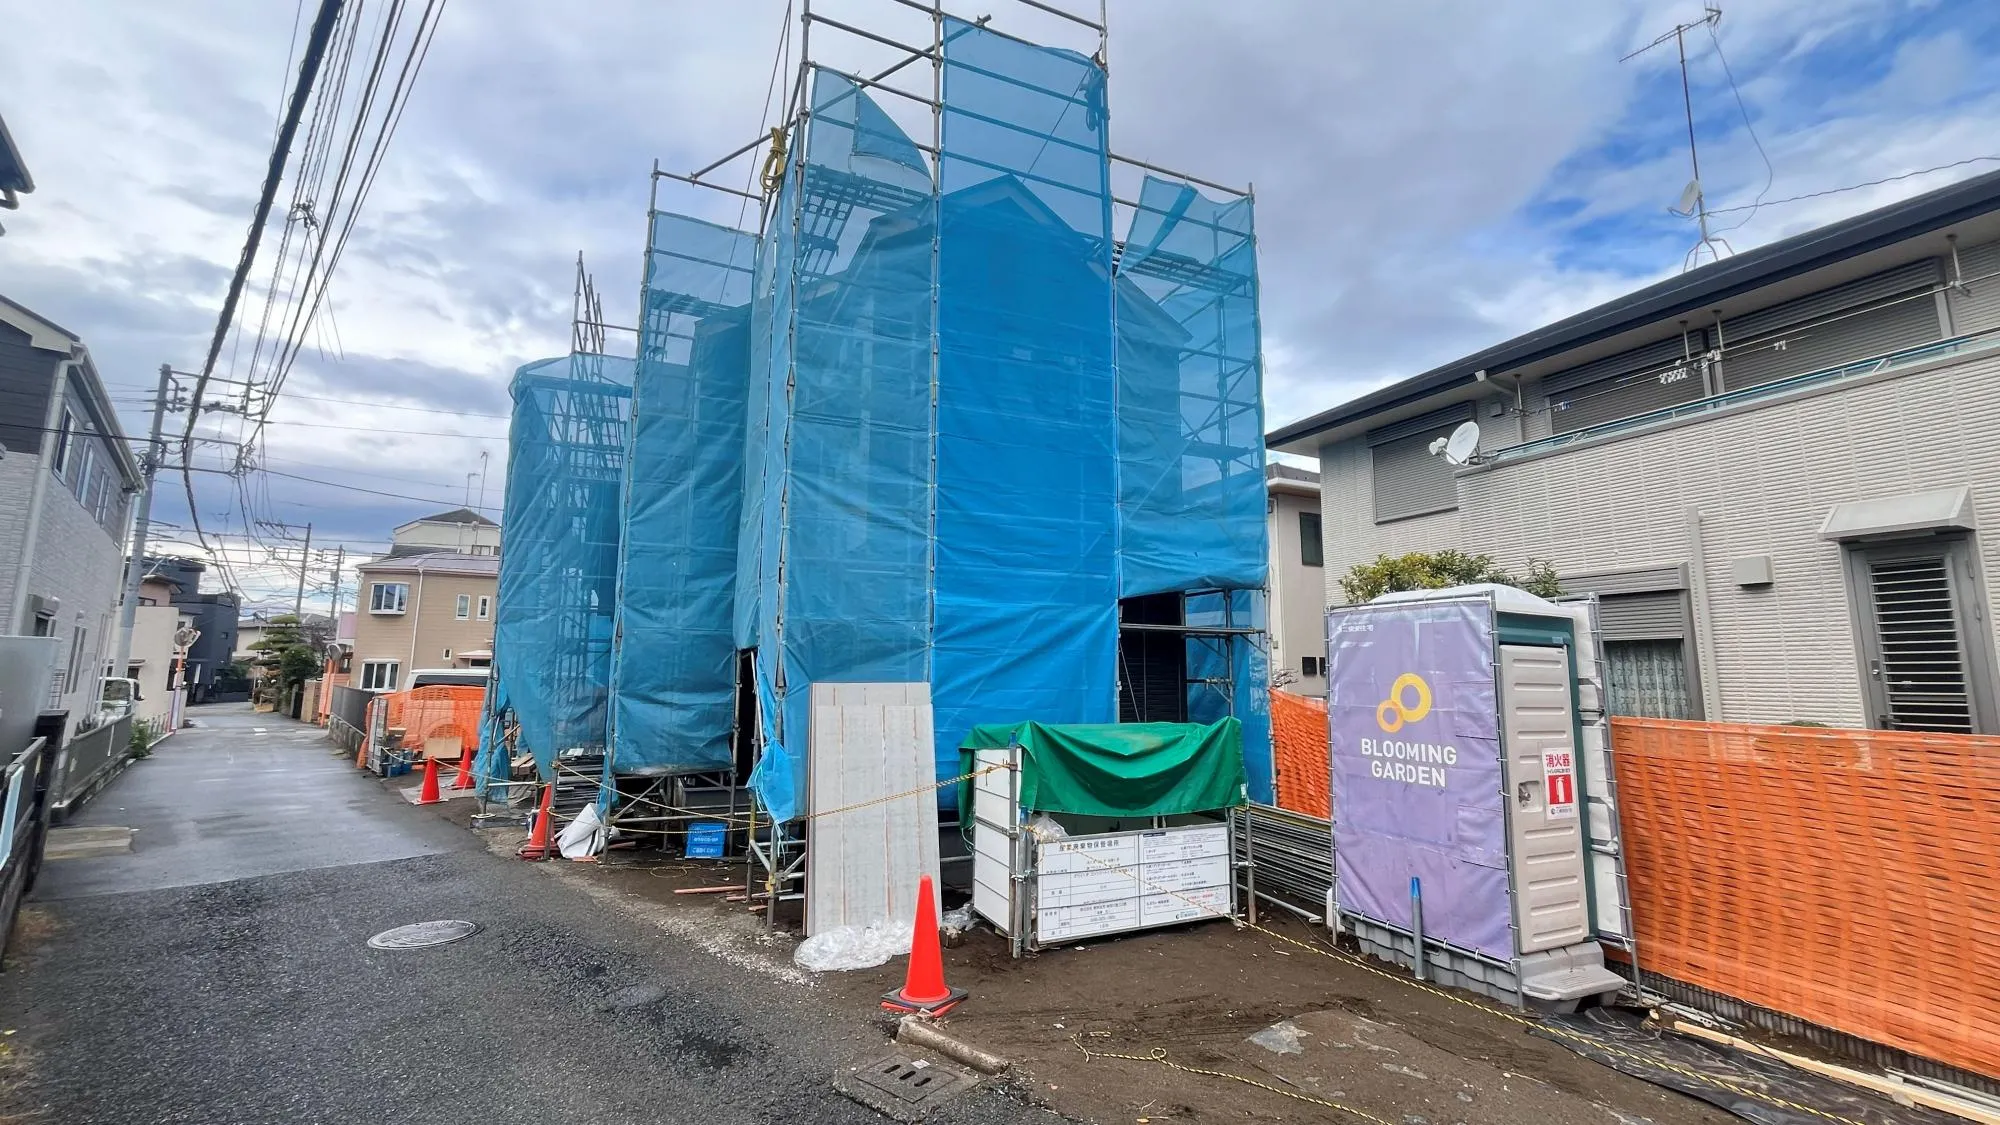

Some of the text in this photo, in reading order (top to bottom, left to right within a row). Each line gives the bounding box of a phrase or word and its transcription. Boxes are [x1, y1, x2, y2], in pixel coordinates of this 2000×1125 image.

[1361, 738, 1457, 765] BLOOMING
[1545, 753, 1571, 768] 消火器
[1371, 760, 1446, 787] GARDEN
